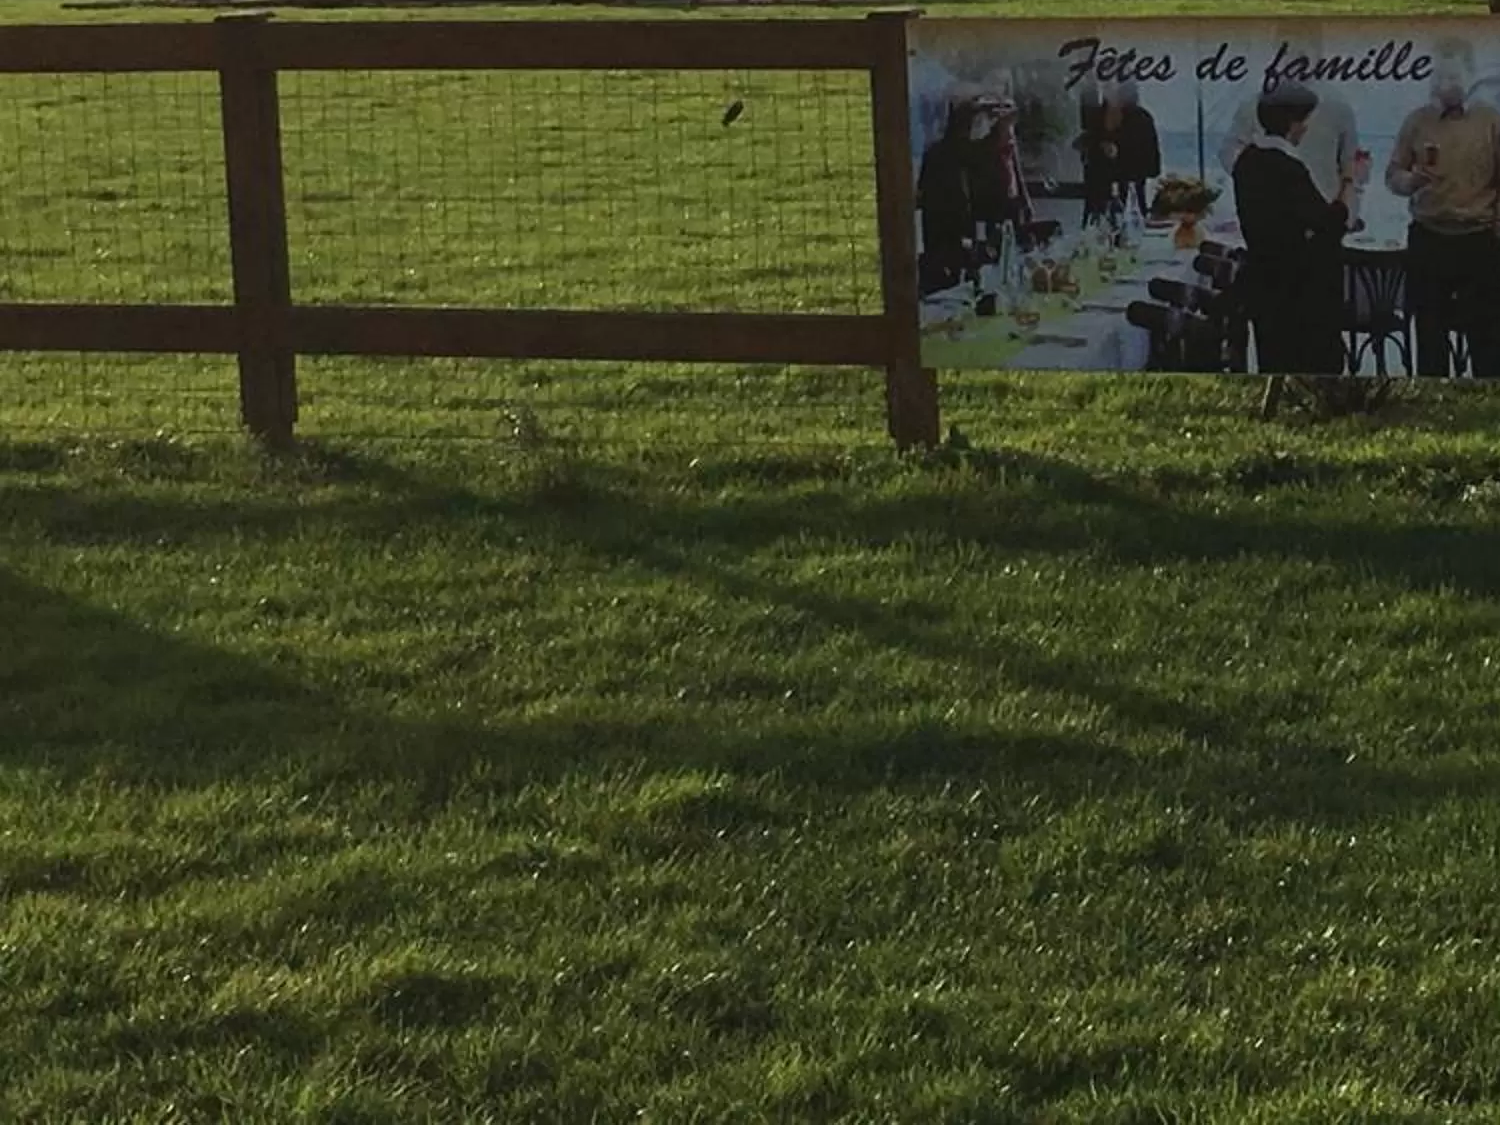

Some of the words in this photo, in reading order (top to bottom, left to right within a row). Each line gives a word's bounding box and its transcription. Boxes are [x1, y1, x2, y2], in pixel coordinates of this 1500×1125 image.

[1058, 38, 1177, 91] Fêtes
[1196, 42, 1249, 81] de
[1263, 40, 1433, 94] famille
